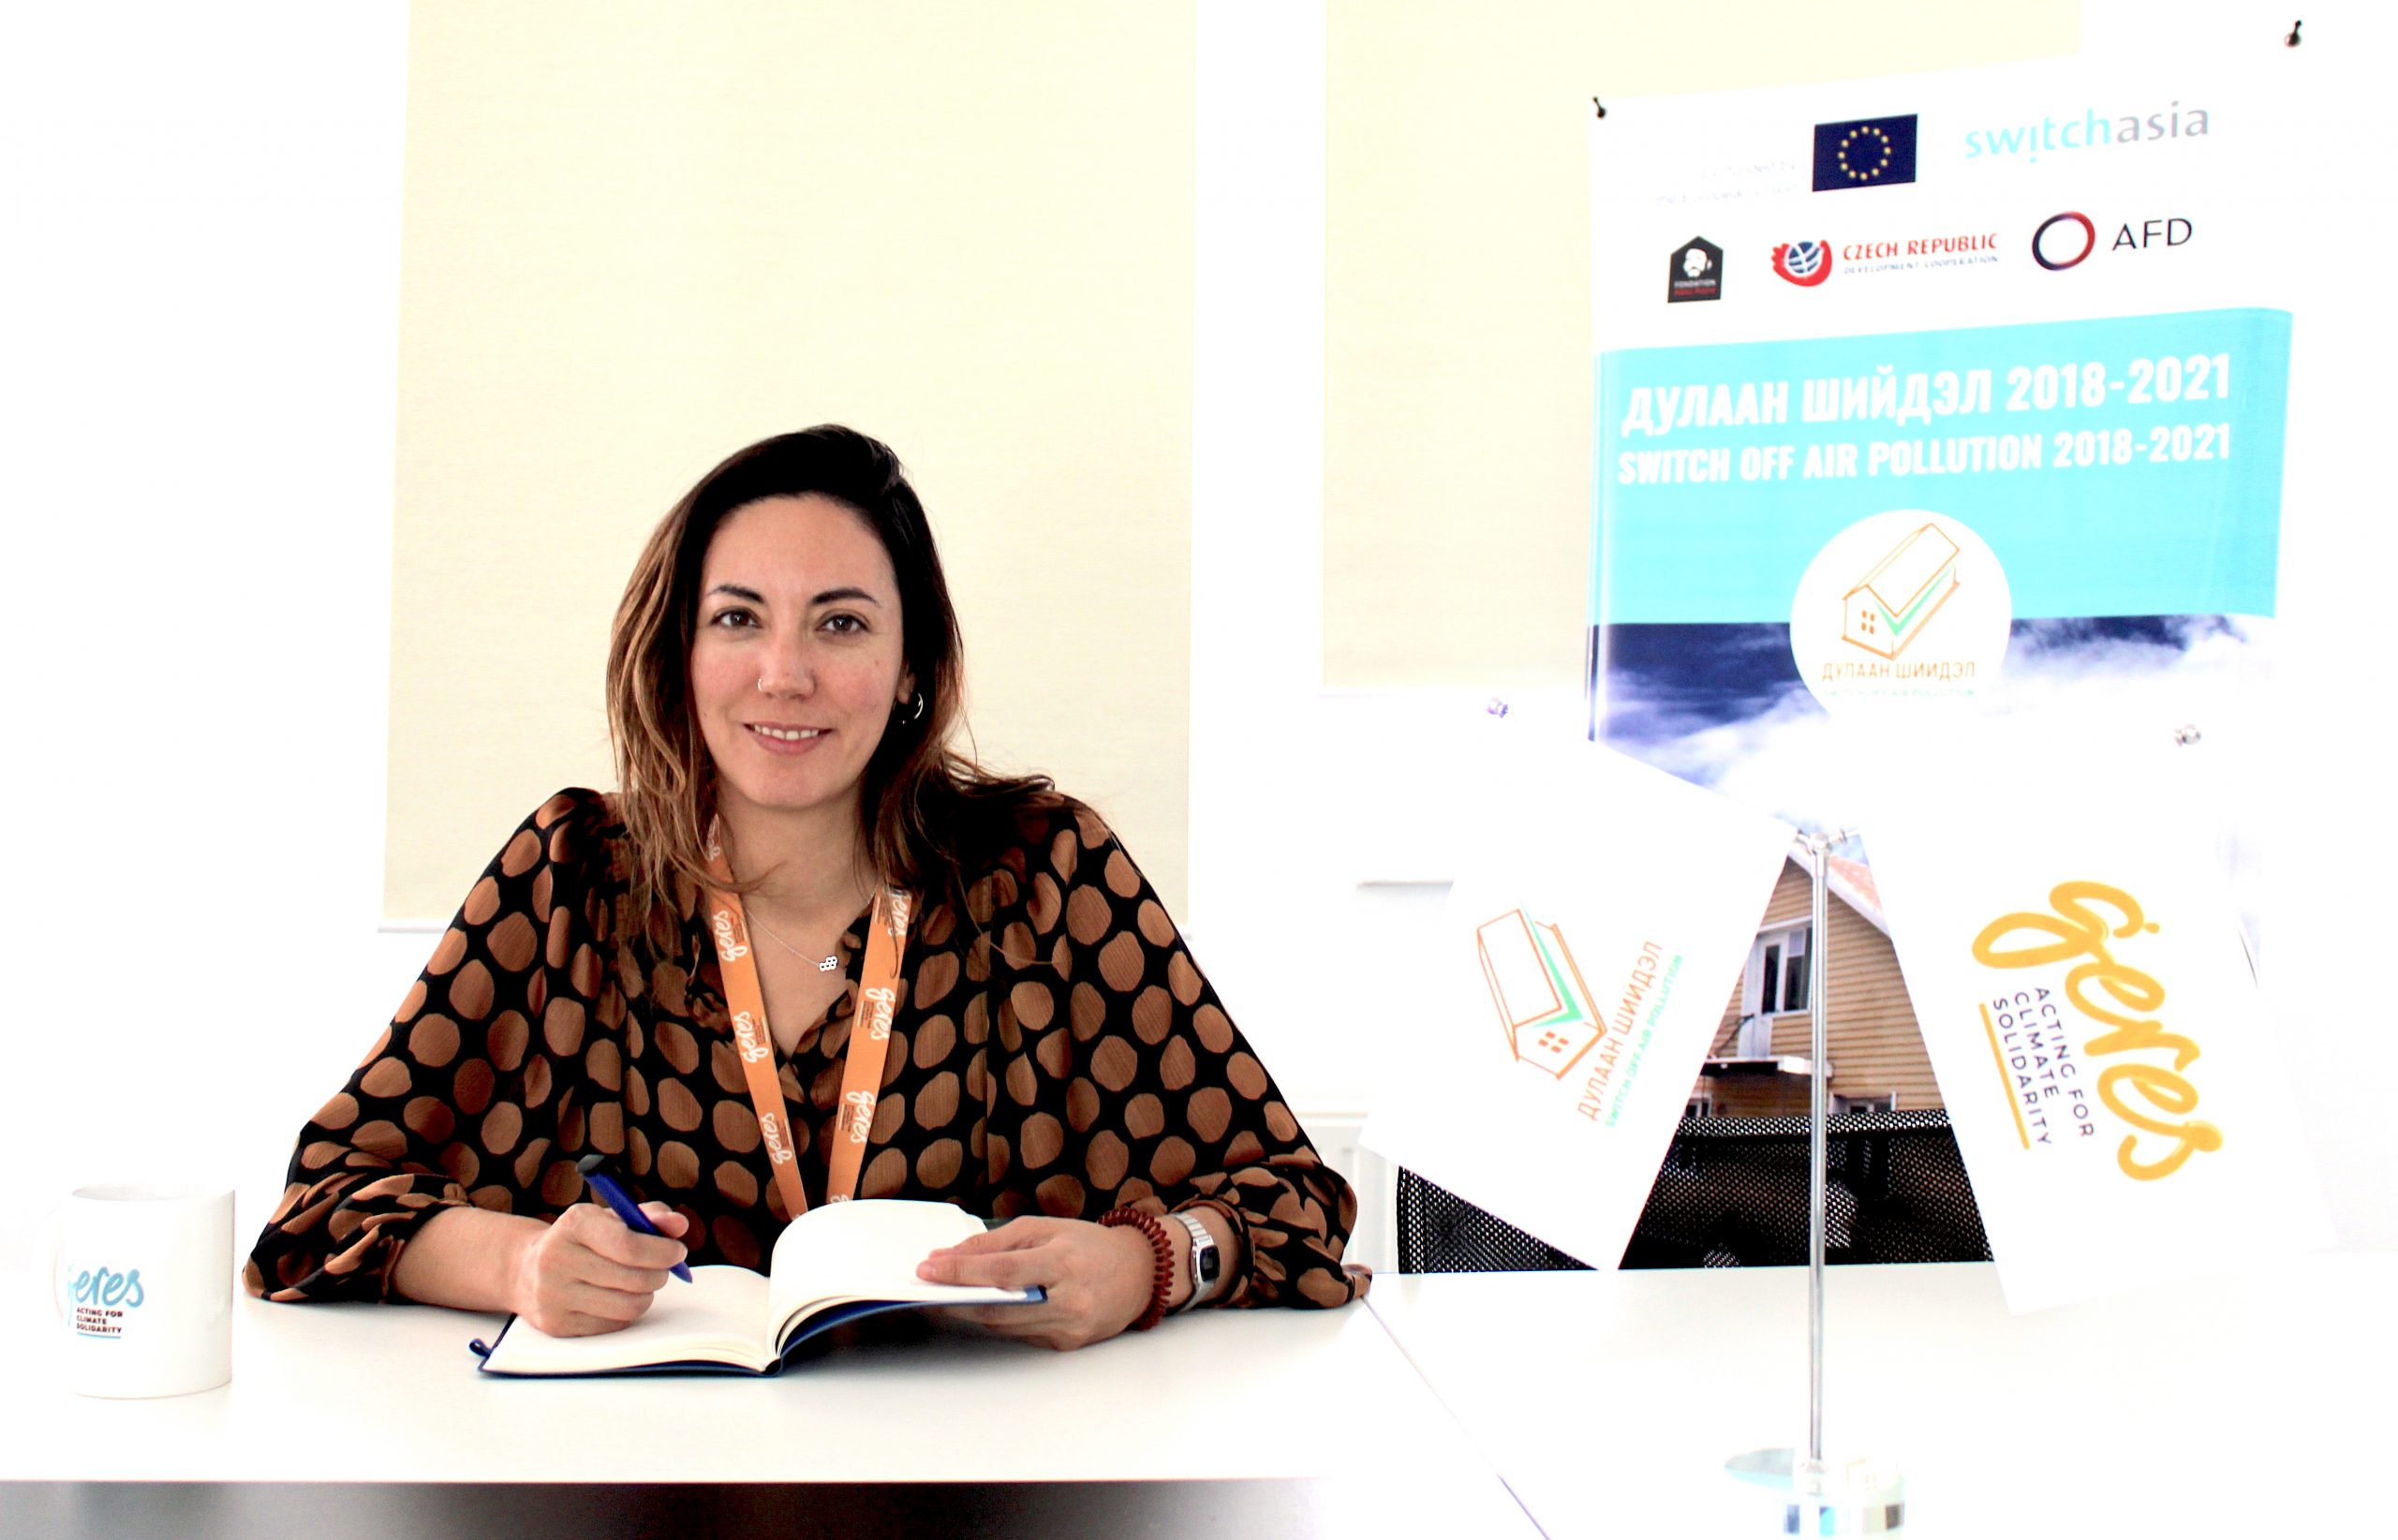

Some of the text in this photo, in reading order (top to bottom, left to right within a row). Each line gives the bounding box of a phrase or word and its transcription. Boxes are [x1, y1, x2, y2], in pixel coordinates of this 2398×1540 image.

[1965, 100, 2209, 163] switchasia
[1843, 233, 1998, 260] CZECH REPUBLIC
[2112, 217, 2193, 251] AFD
[1621, 352, 2229, 438] ДУЛААН ШИЙДЭЛ 2018-2021
[1618, 422, 2230, 485] SWITCH OFF AIR POLLUTION 2018-2021
[1972, 881, 2223, 1181] geres
[2014, 991, 2060, 1098] CLIMATE
[2035, 987, 2095, 1137] ACTING FOR
[1992, 998, 2051, 1145] SOLIDARITY
[76, 1307, 123, 1318] ACTING FOR
[76, 1315, 107, 1325] CLIMATE
[76, 1323, 122, 1333] SOLIDARITY
